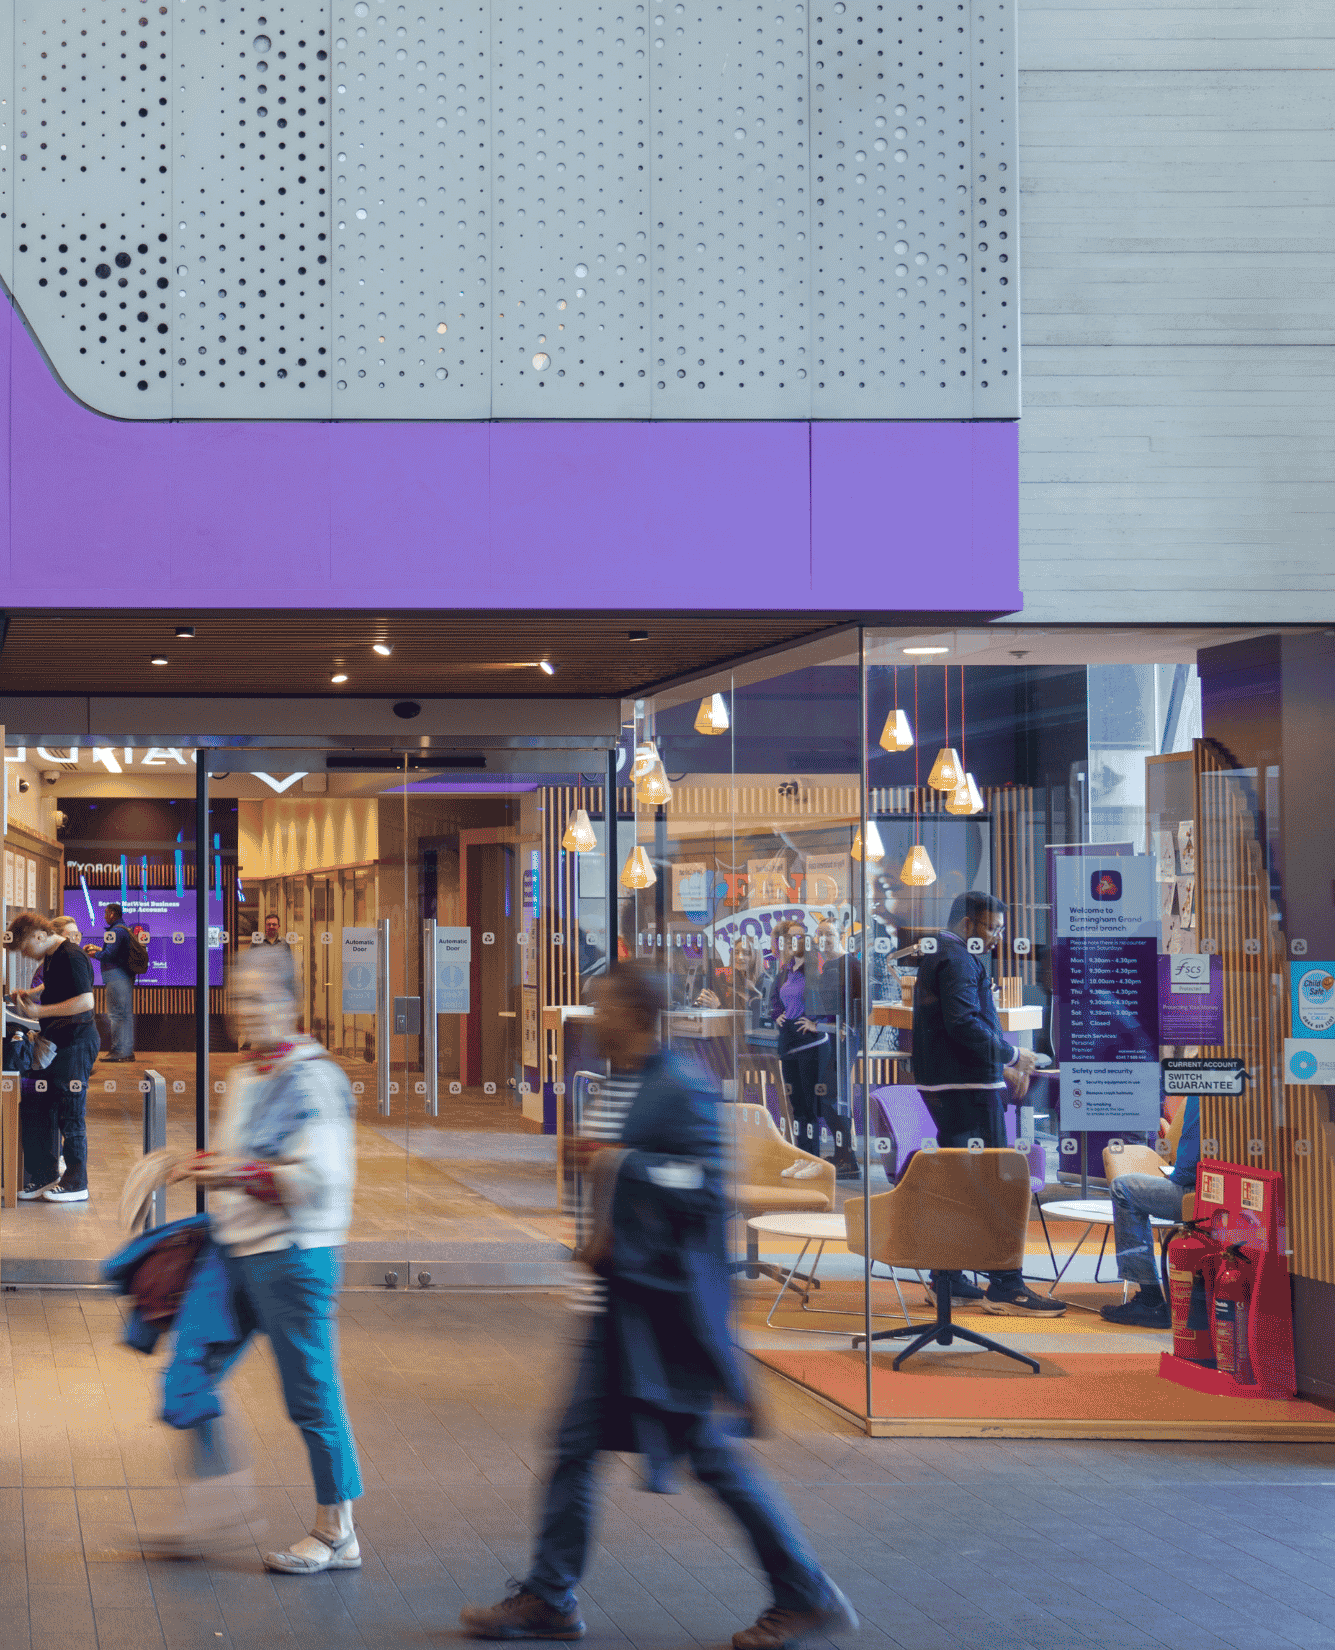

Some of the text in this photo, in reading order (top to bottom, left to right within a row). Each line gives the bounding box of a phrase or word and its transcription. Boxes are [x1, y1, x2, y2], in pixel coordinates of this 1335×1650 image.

[723, 873, 839, 907] FIND
[1069, 906, 1105, 914] Welcome
[1069, 915, 1117, 924] Birmingham
[1303, 979, 1321, 987] Child
[1309, 987, 1324, 996] Safe
[1071, 1067, 1093, 1075] Safety
[1107, 1067, 1133, 1075] security
[1168, 1081, 1234, 1089] GUARANTEE
